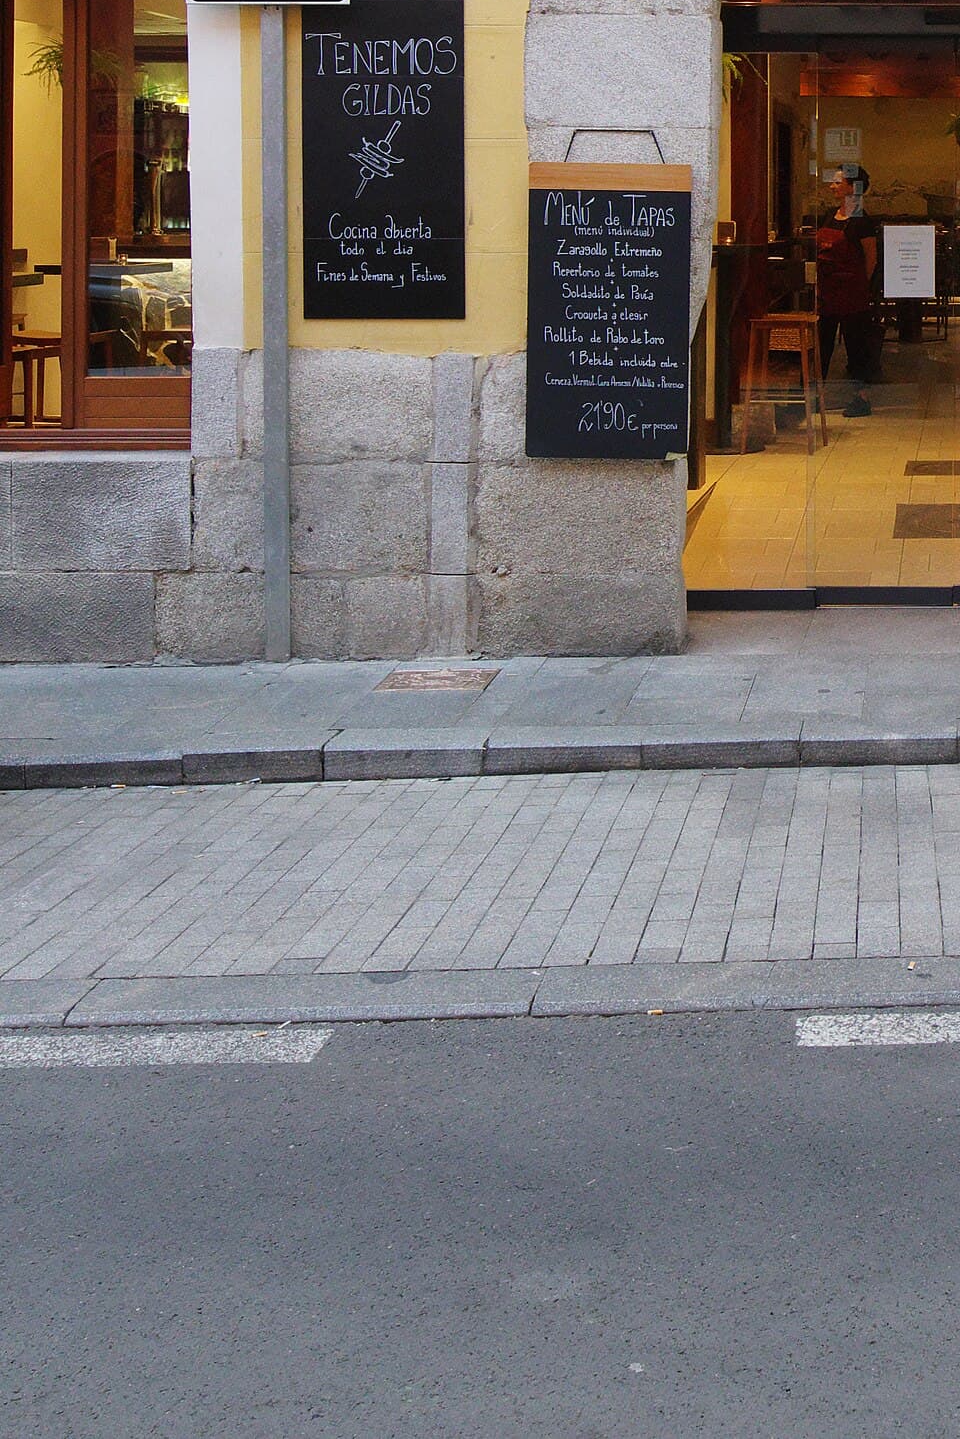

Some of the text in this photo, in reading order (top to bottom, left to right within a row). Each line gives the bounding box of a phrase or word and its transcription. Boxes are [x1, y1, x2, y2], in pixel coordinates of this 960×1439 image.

[305, 32, 456, 75] TENEMOS
[342, 83, 432, 115] GILDAS
[605, 201, 620, 226] de
[622, 194, 676, 227] TAPAS
[329, 213, 376, 240] Cocina
[340, 241, 364, 255] todo
[376, 242, 386, 255] el
[614, 242, 662, 257] Extremeño
[318, 262, 446, 288] Fines de Semana y Festivos
[553, 262, 659, 278] Repertorio de tomates
[562, 283, 653, 300] Soldadito de Pavía
[565, 305, 608, 320] Croqueta
[620, 307, 649, 320] elegir
[544, 326, 665, 345] Rollito de Rabo de toro
[569, 351, 575, 365] 1
[580, 350, 613, 366] Bebida
[620, 354, 656, 367] incluida
[642, 423, 678, 440] por persona
